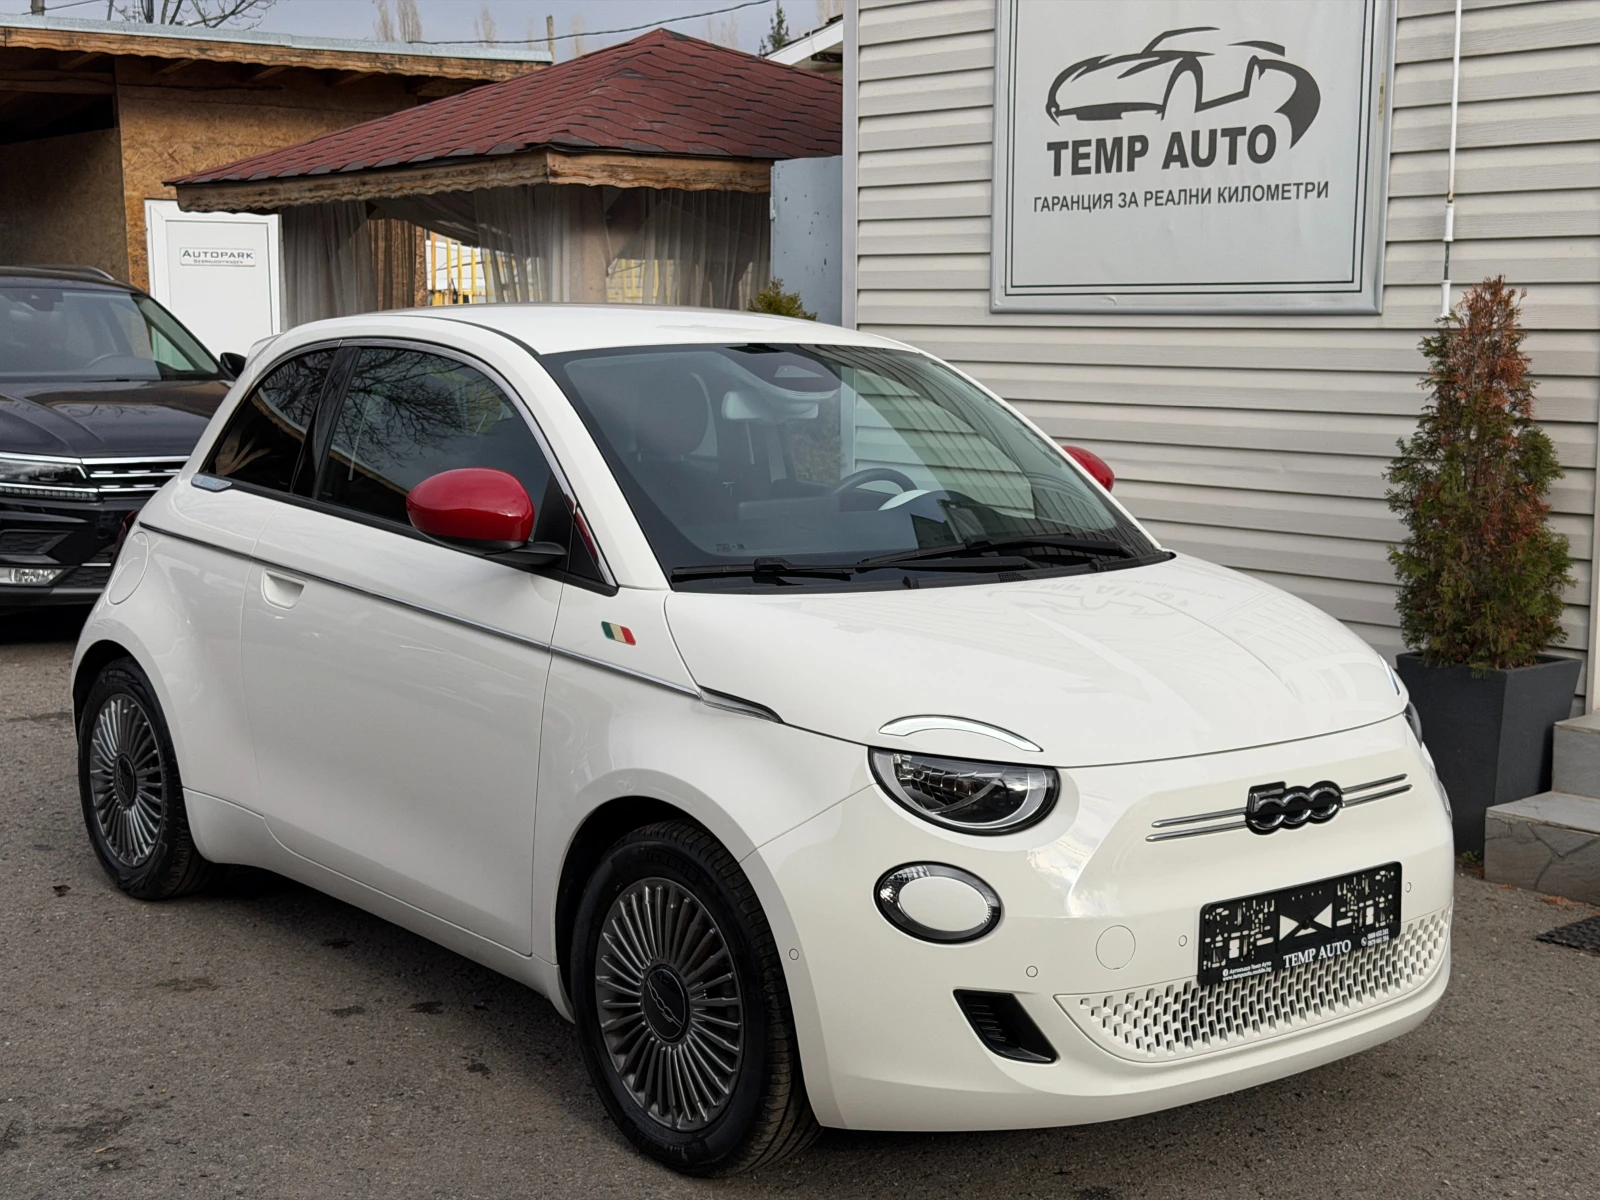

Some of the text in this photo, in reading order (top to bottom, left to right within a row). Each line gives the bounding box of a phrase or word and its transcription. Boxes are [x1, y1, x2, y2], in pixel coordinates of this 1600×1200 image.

[1046, 124, 1277, 177] TEMP AUTO
[1033, 180, 1329, 213] ГАРАНЦИЯ ЗА РЕАЛНИ КИЛОМЕТРИ
[182, 250, 253, 260] AUTOPARK
[1245, 780, 1342, 836] 500
[1283, 948, 1316, 968] TEMP
[1318, 939, 1352, 960] AUTO
